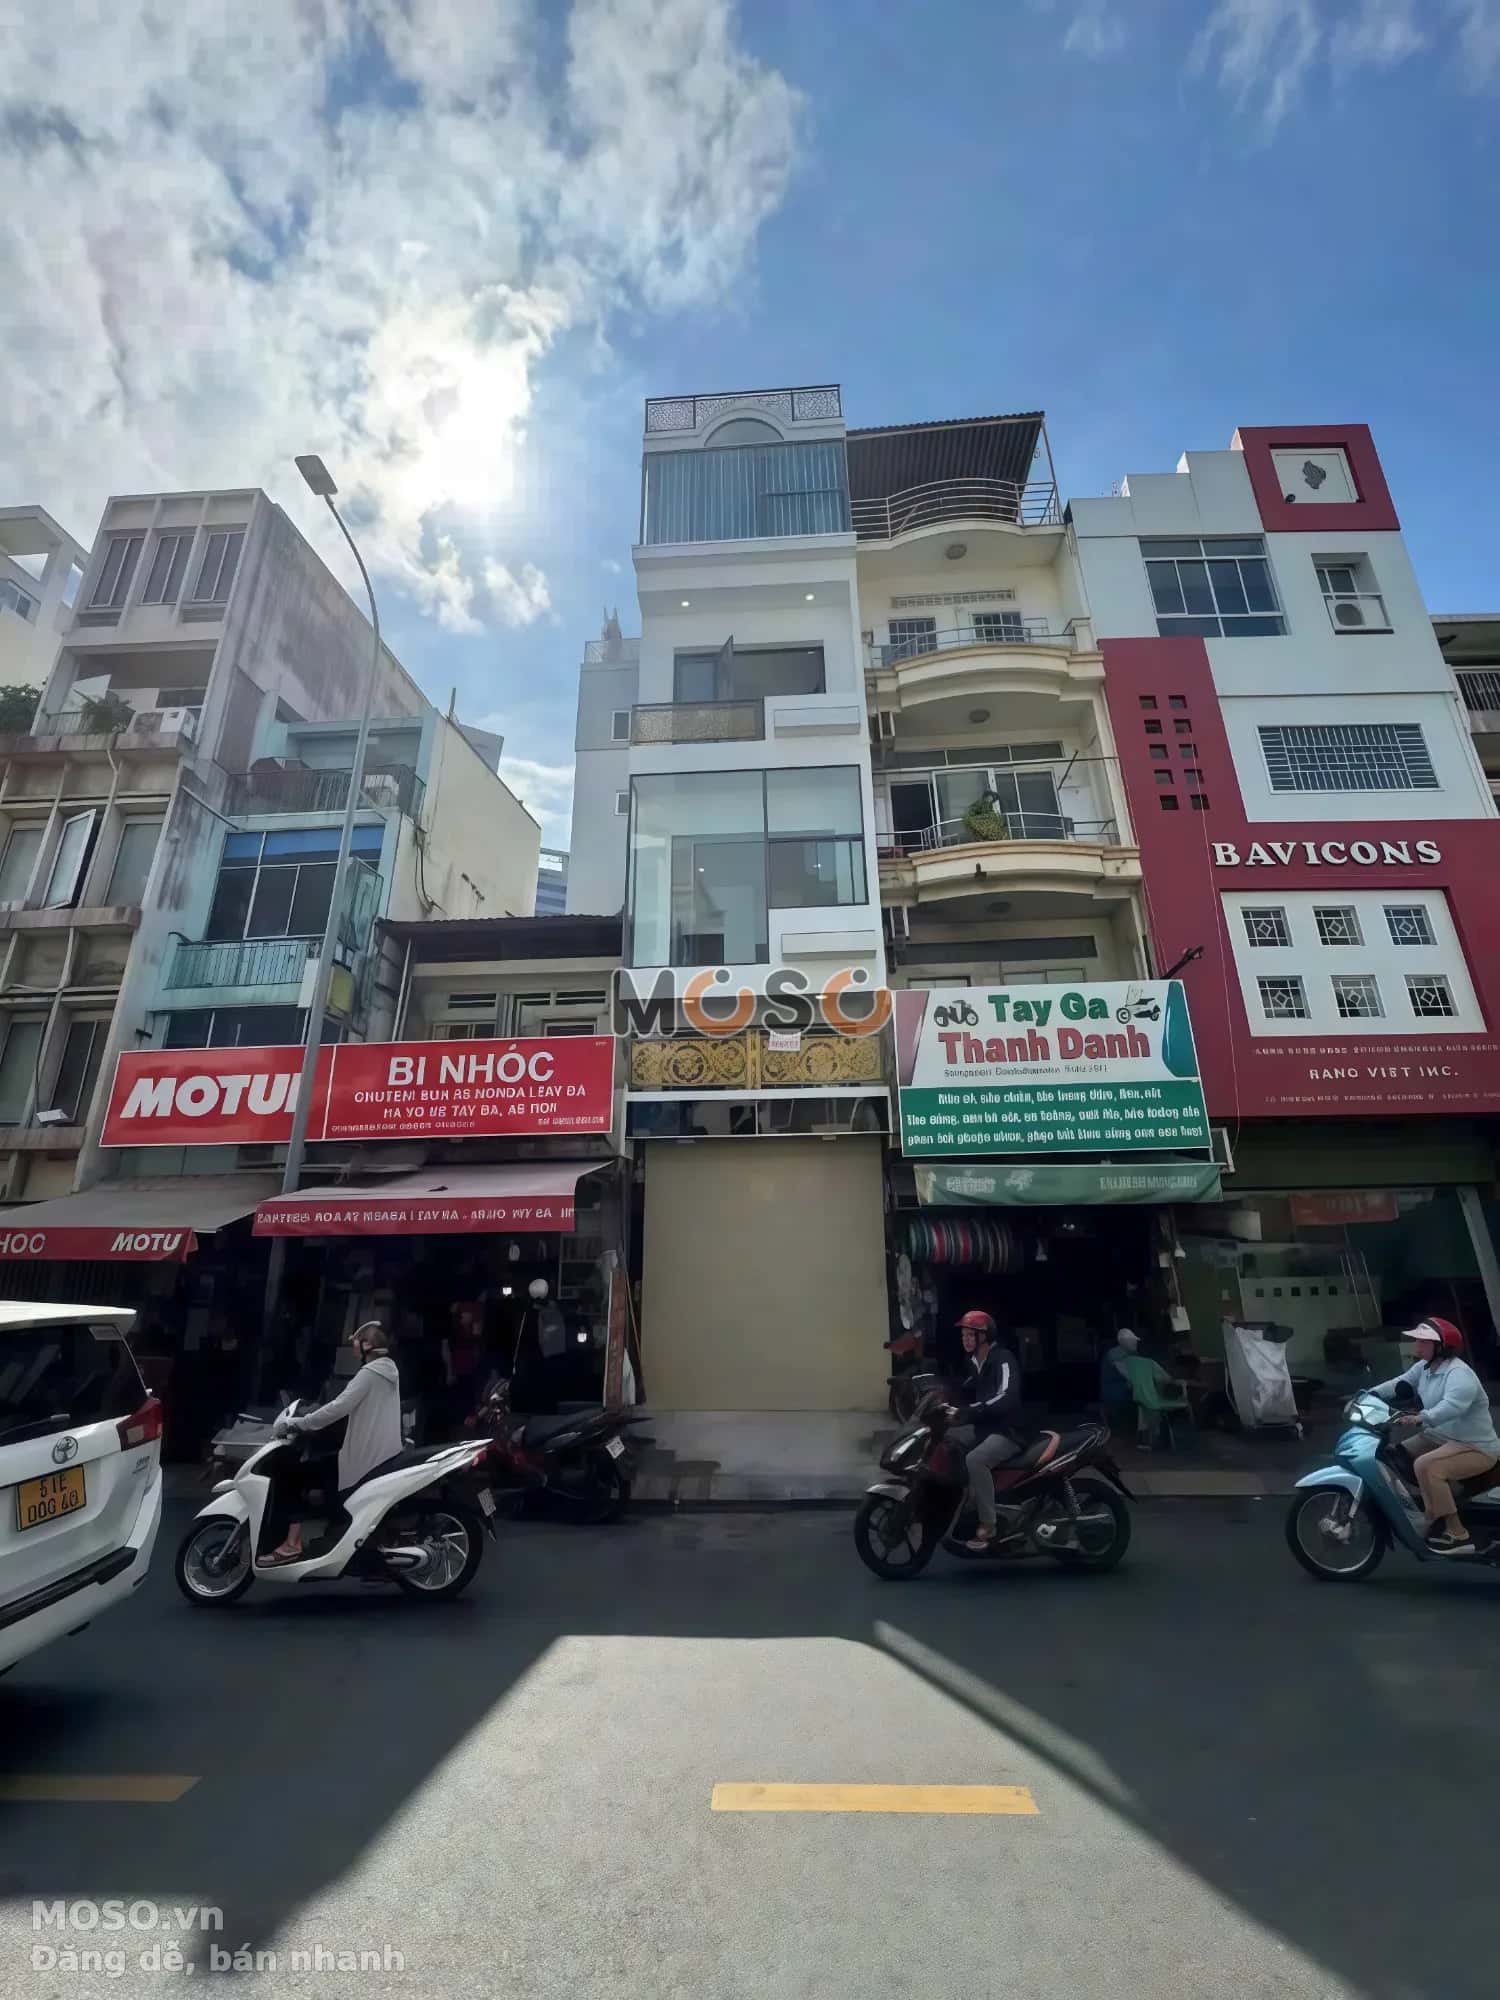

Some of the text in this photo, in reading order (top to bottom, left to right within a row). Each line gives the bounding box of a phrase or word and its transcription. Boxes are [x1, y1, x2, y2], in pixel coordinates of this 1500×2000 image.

[1212, 840, 1441, 866] BAVICONS
[987, 992, 1109, 1026] Tay Ga
[938, 1025, 1152, 1065] Thanh Danh
[387, 1044, 554, 1086] BI NHÓC
